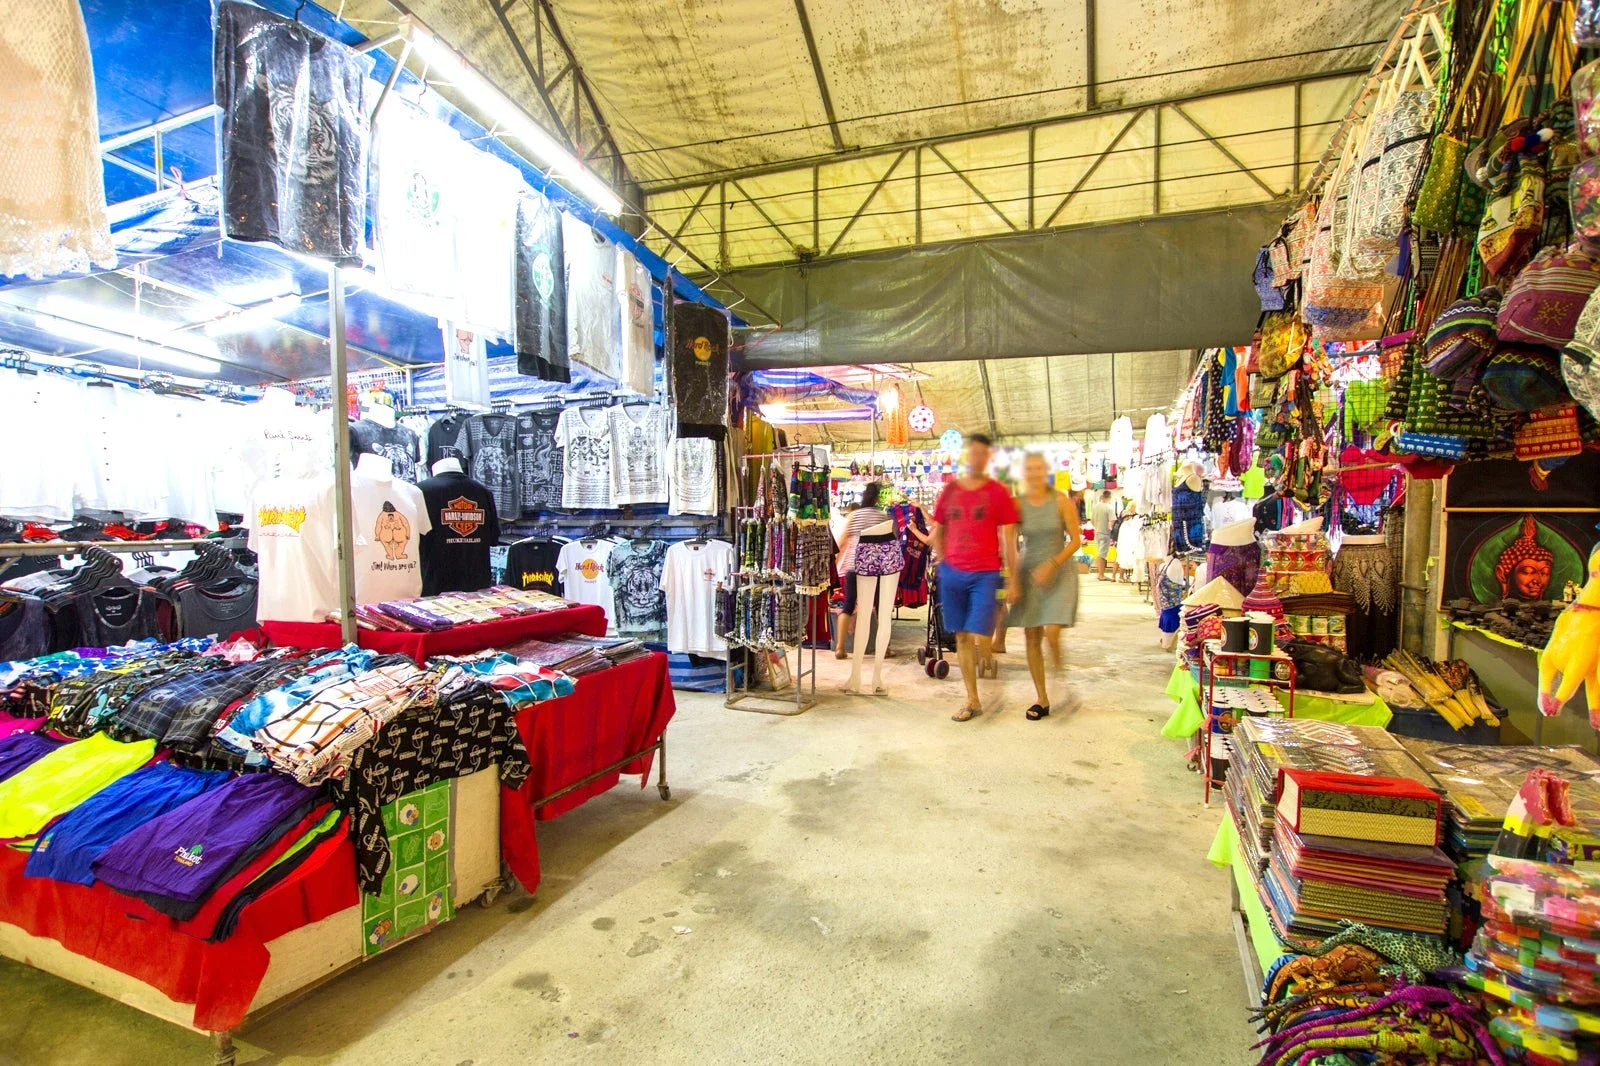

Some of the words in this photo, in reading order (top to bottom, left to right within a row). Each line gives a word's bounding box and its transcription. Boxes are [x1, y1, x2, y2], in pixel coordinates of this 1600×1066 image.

[444, 512, 482, 521] HARLEY-DAVIDSON
[371, 561, 383, 571] Jim!
[174, 846, 203, 865] Phuket
